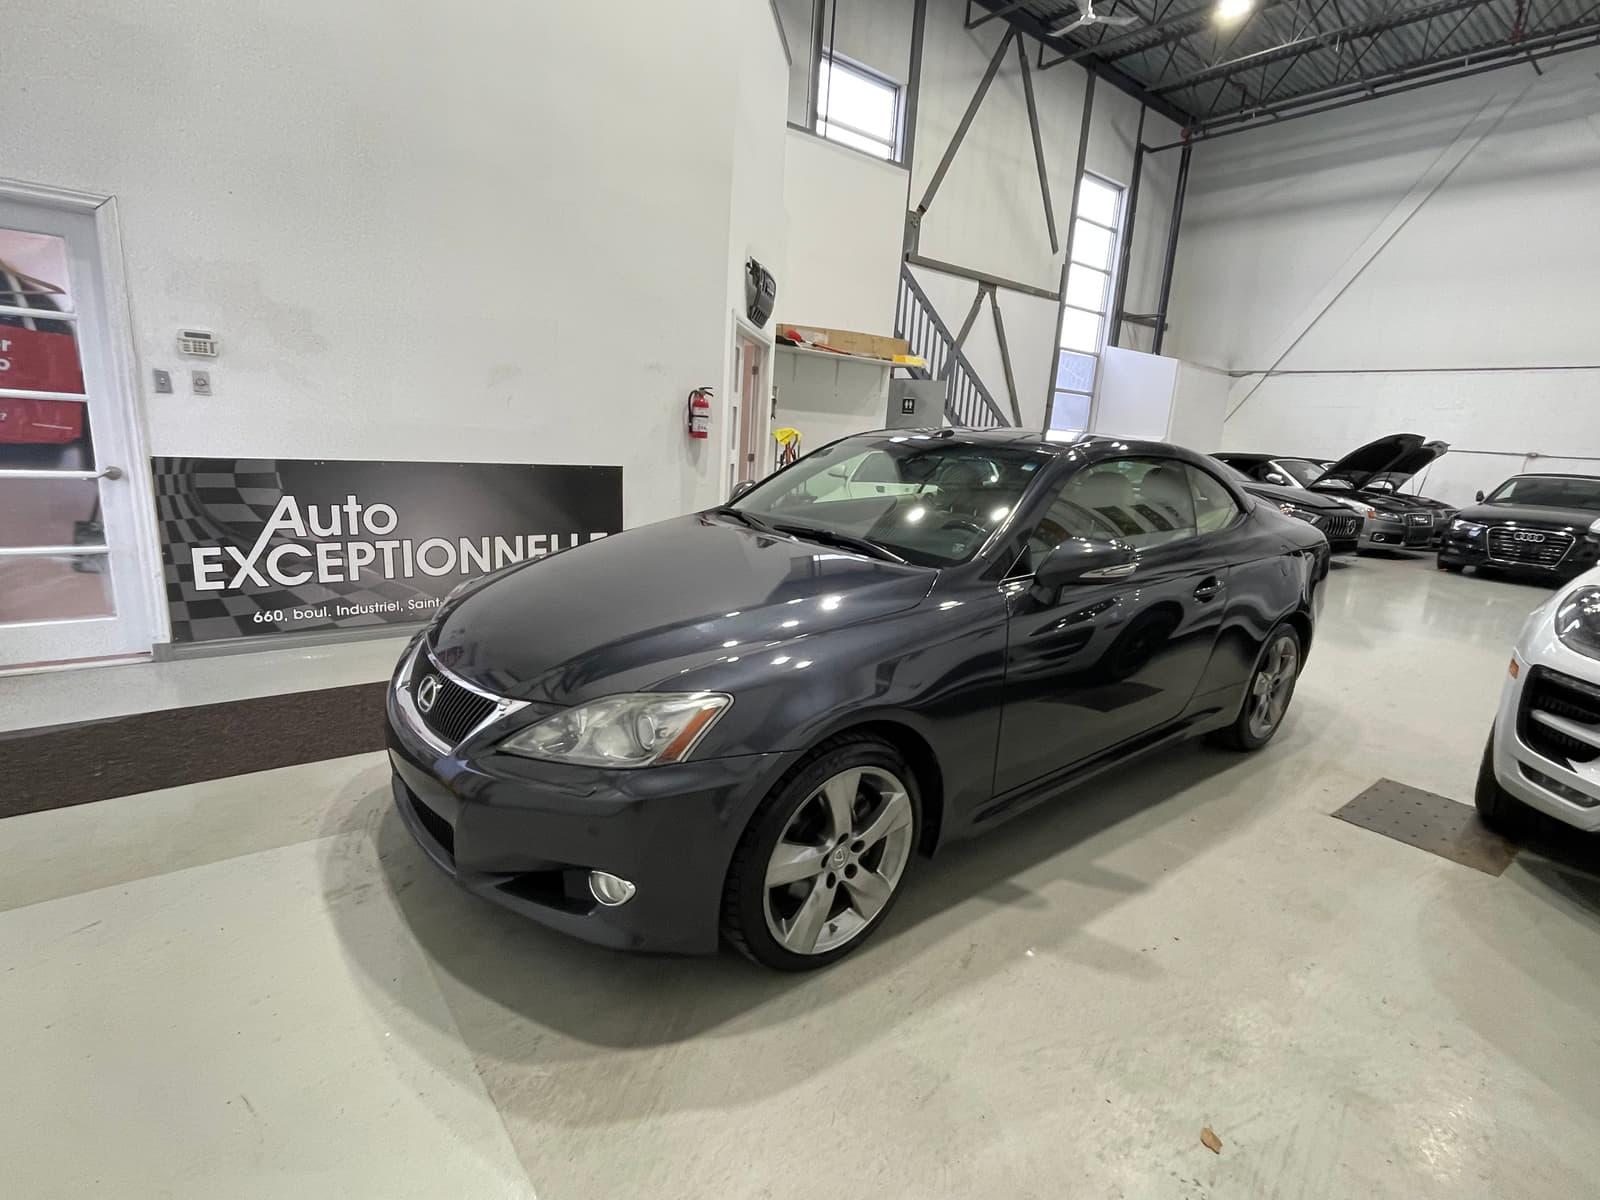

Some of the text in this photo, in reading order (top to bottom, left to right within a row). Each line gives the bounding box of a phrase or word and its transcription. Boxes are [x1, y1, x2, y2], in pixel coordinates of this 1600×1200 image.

[262, 495, 398, 537] Auto
[191, 532, 608, 591] EXCEPTIONNE
[253, 609, 288, 623] 660,
[293, 606, 331, 620] boul.
[336, 600, 404, 616] Industriel,
